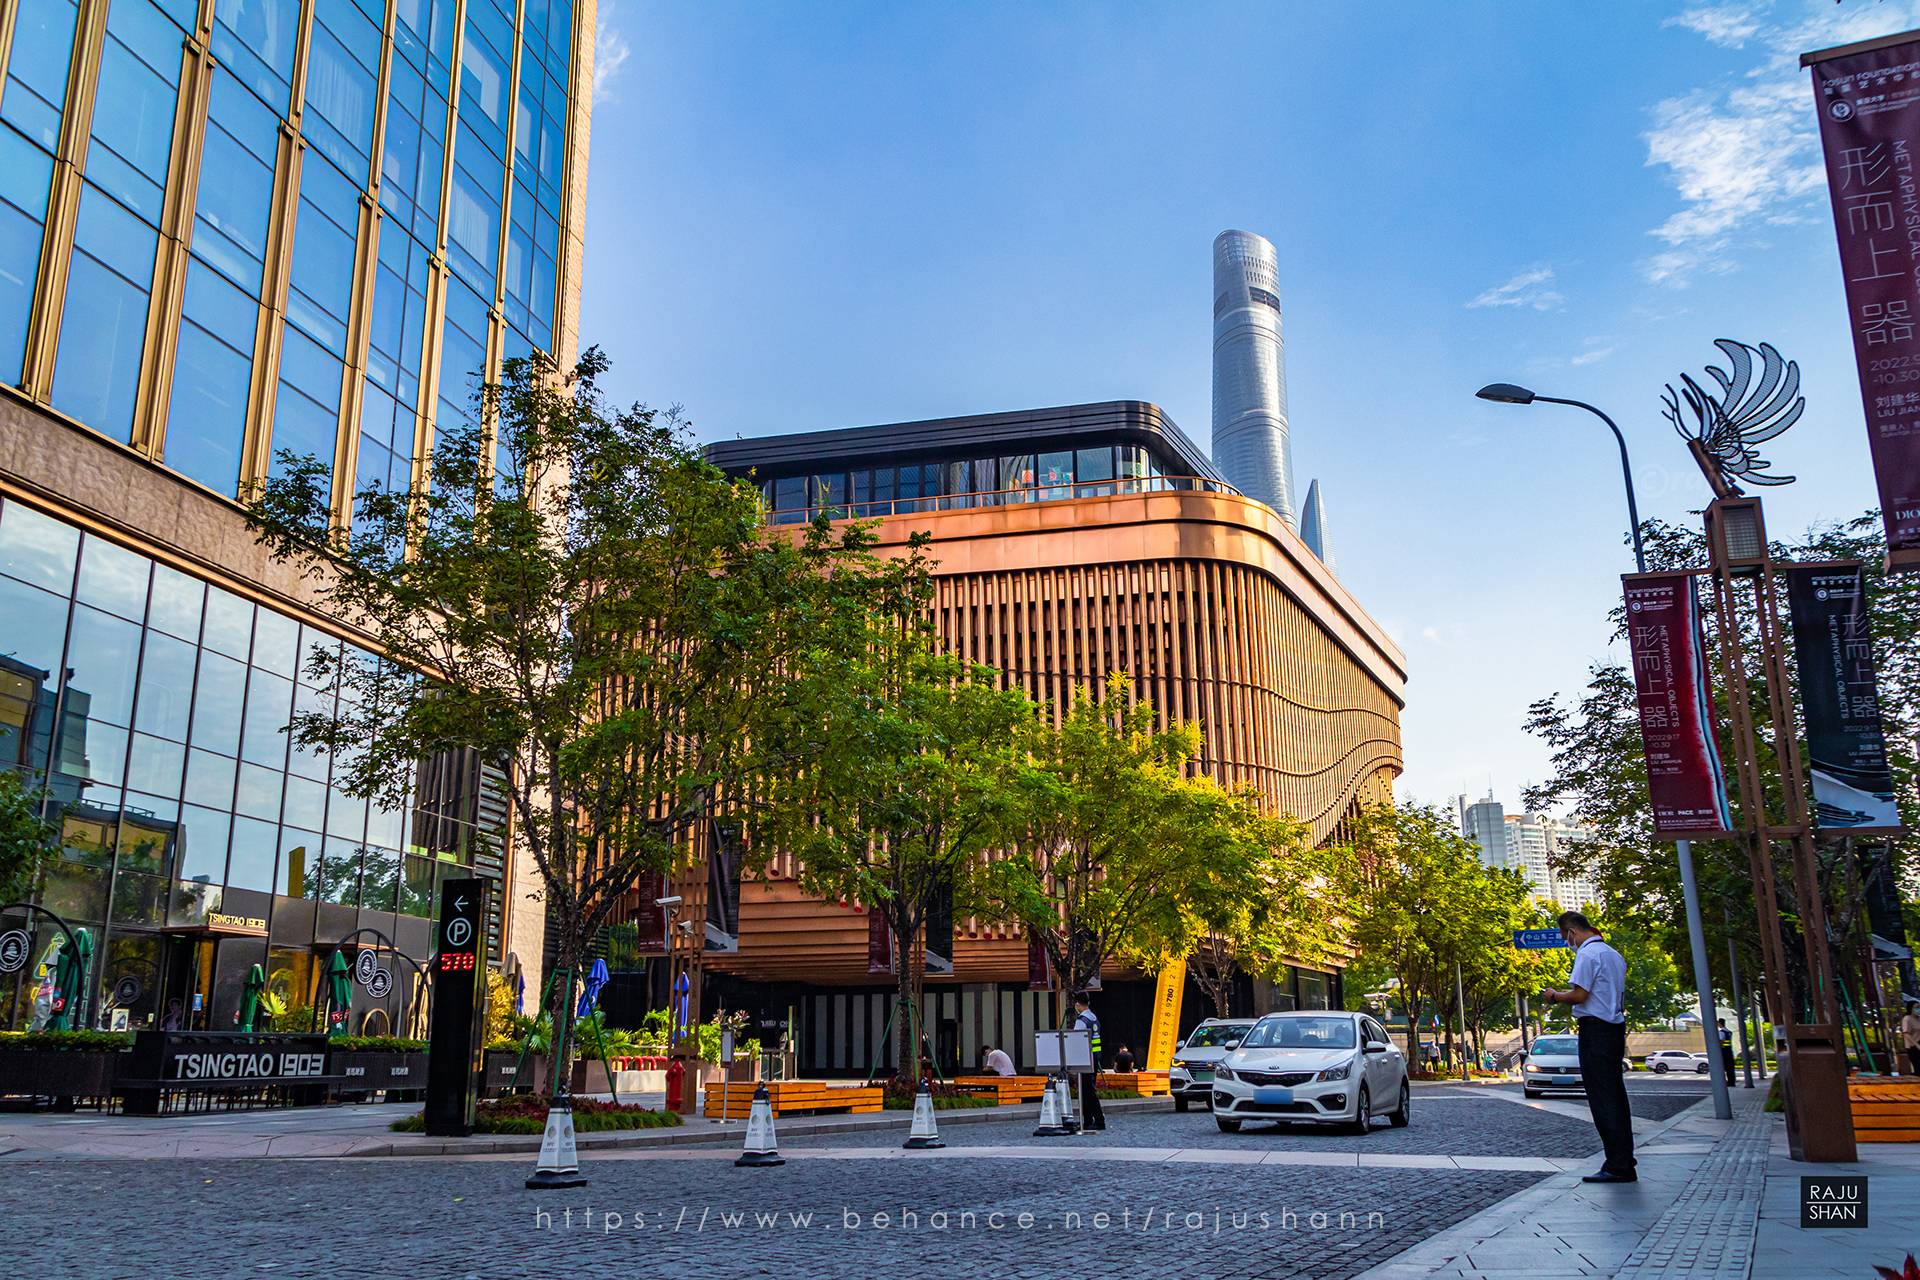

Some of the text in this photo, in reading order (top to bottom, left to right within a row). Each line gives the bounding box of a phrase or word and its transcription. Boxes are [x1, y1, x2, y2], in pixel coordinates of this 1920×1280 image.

[1875, 391, 1920, 409] 刘建华
[1877, 408, 1896, 418] LIU
[1828, 614, 1850, 719] METAPHYSICAL OBJECTS
[1660, 625, 1680, 728] METAPHYSICAL OBJECTS
[208, 912, 266, 929] TSINGTAO 1903
[441, 952, 475, 971] 570
[174, 1053, 325, 1079] TSINGTAO 1903
